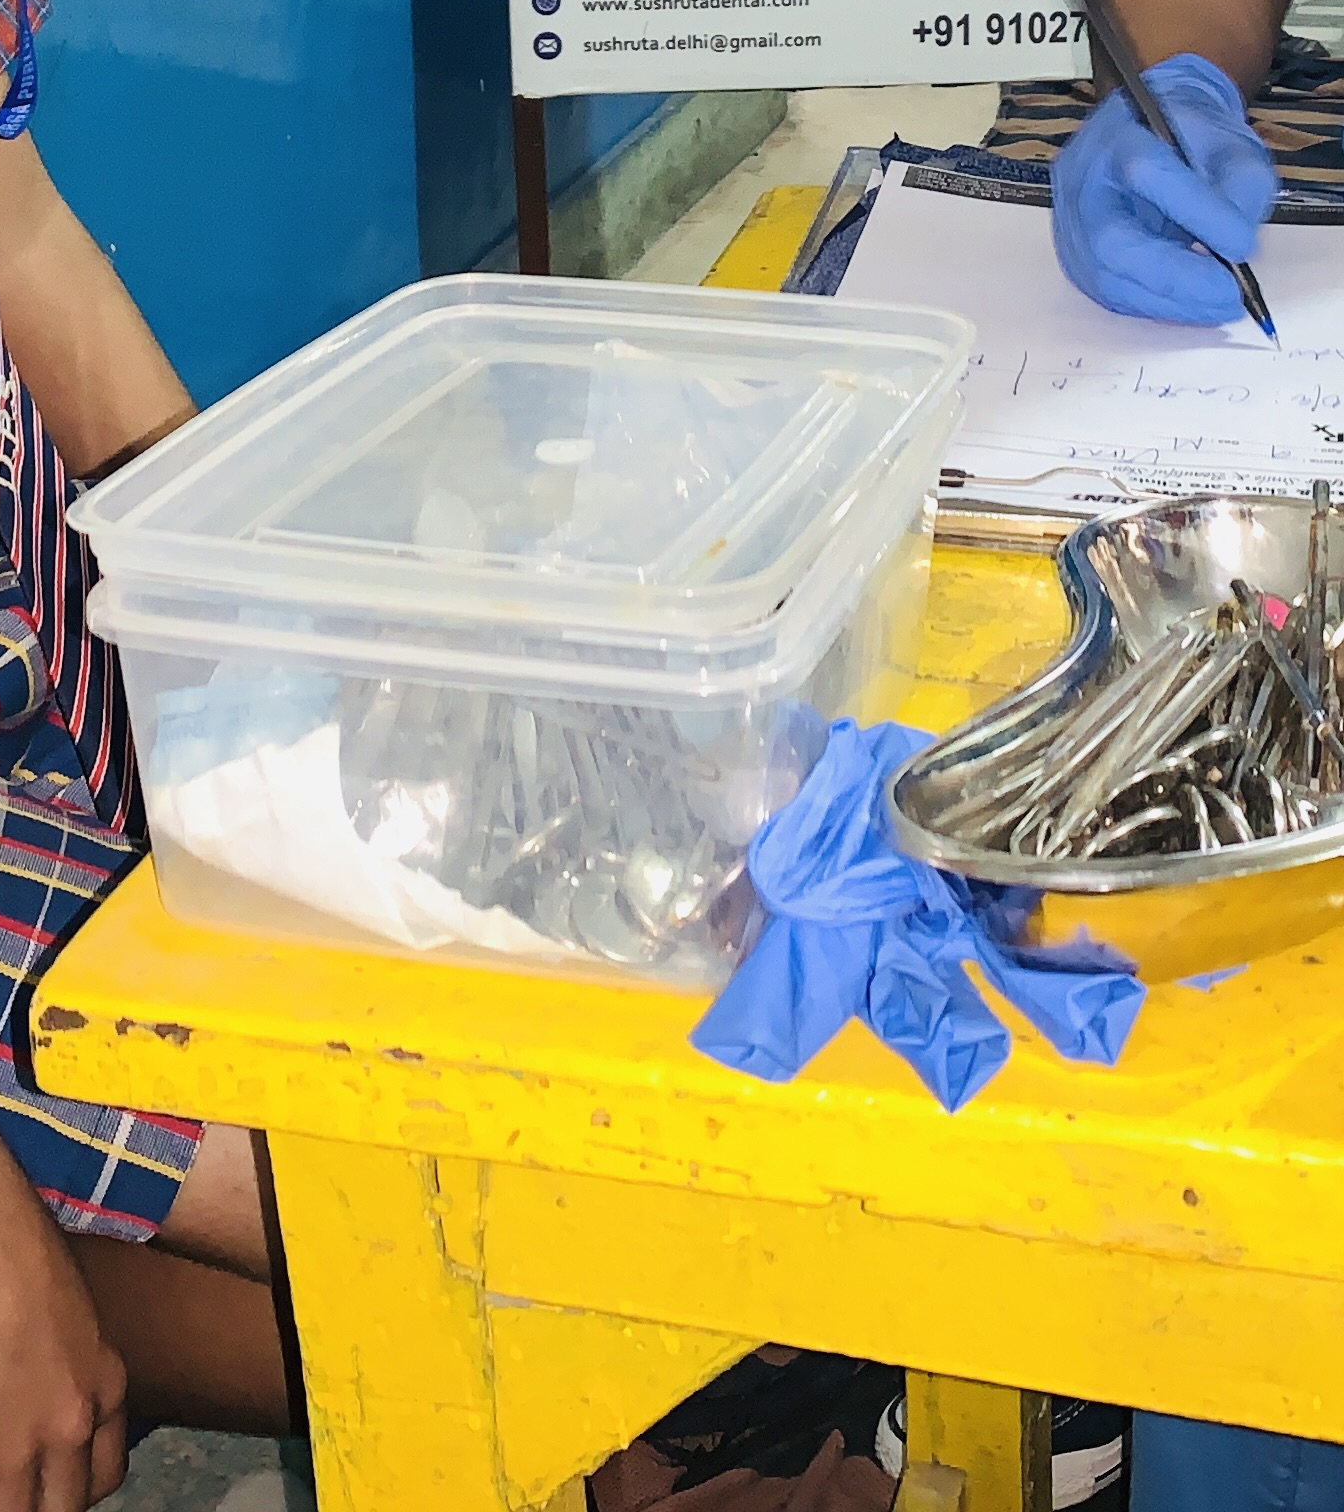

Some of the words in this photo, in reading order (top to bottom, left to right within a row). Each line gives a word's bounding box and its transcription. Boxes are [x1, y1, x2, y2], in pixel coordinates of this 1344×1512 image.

[583, 31, 822, 54] sushruta.delhi@gmail.com
[912, 14, 971, 48] +91
[985, 10, 1089, 46] 91027
